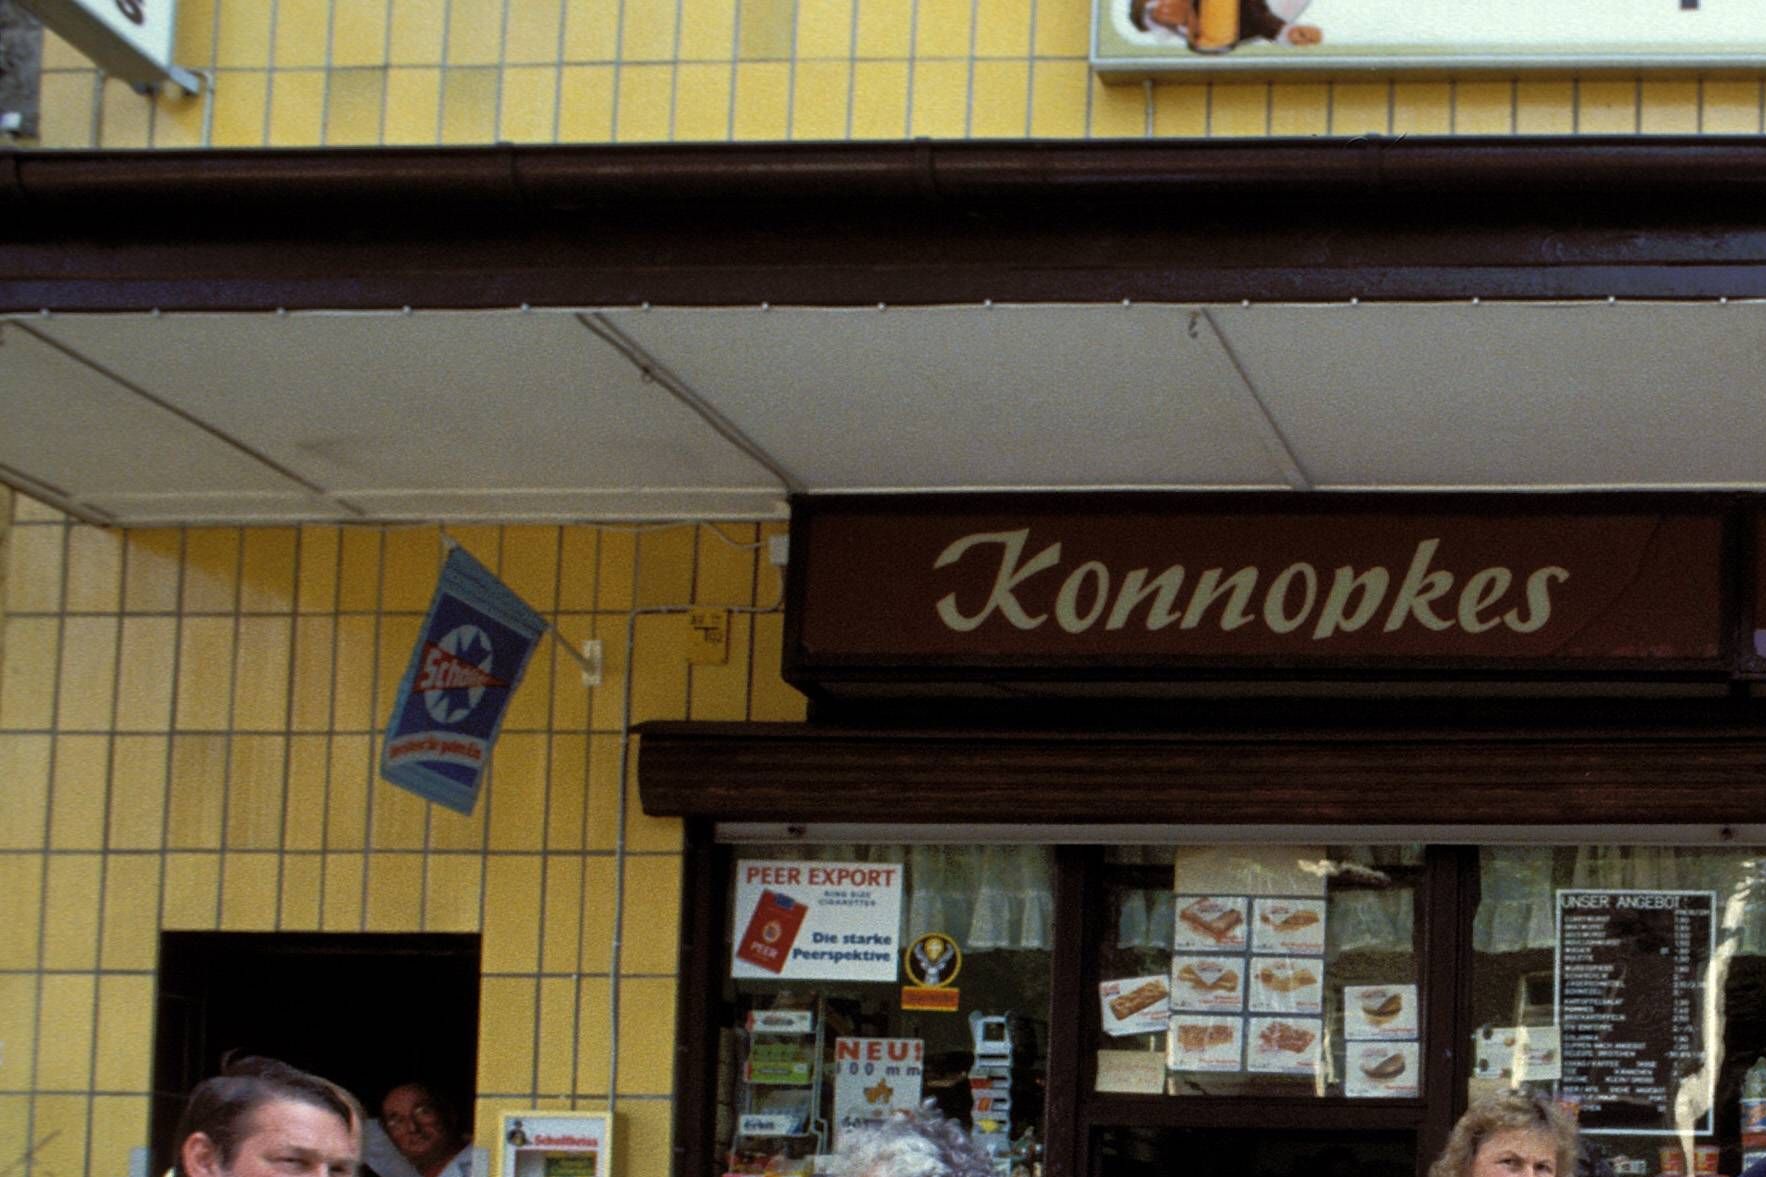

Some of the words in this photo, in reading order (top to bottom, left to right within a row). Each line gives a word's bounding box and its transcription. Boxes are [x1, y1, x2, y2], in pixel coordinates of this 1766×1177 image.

[934, 528, 1569, 640] Konnopkes
[746, 867, 801, 886] PEER
[807, 868, 895, 888] EXPORT
[1561, 895, 1610, 909] UNSER
[812, 931, 838, 945] Die
[842, 932, 892, 945] starke
[792, 948, 891, 964] Peerspektive
[837, 1041, 922, 1062] NEU!
